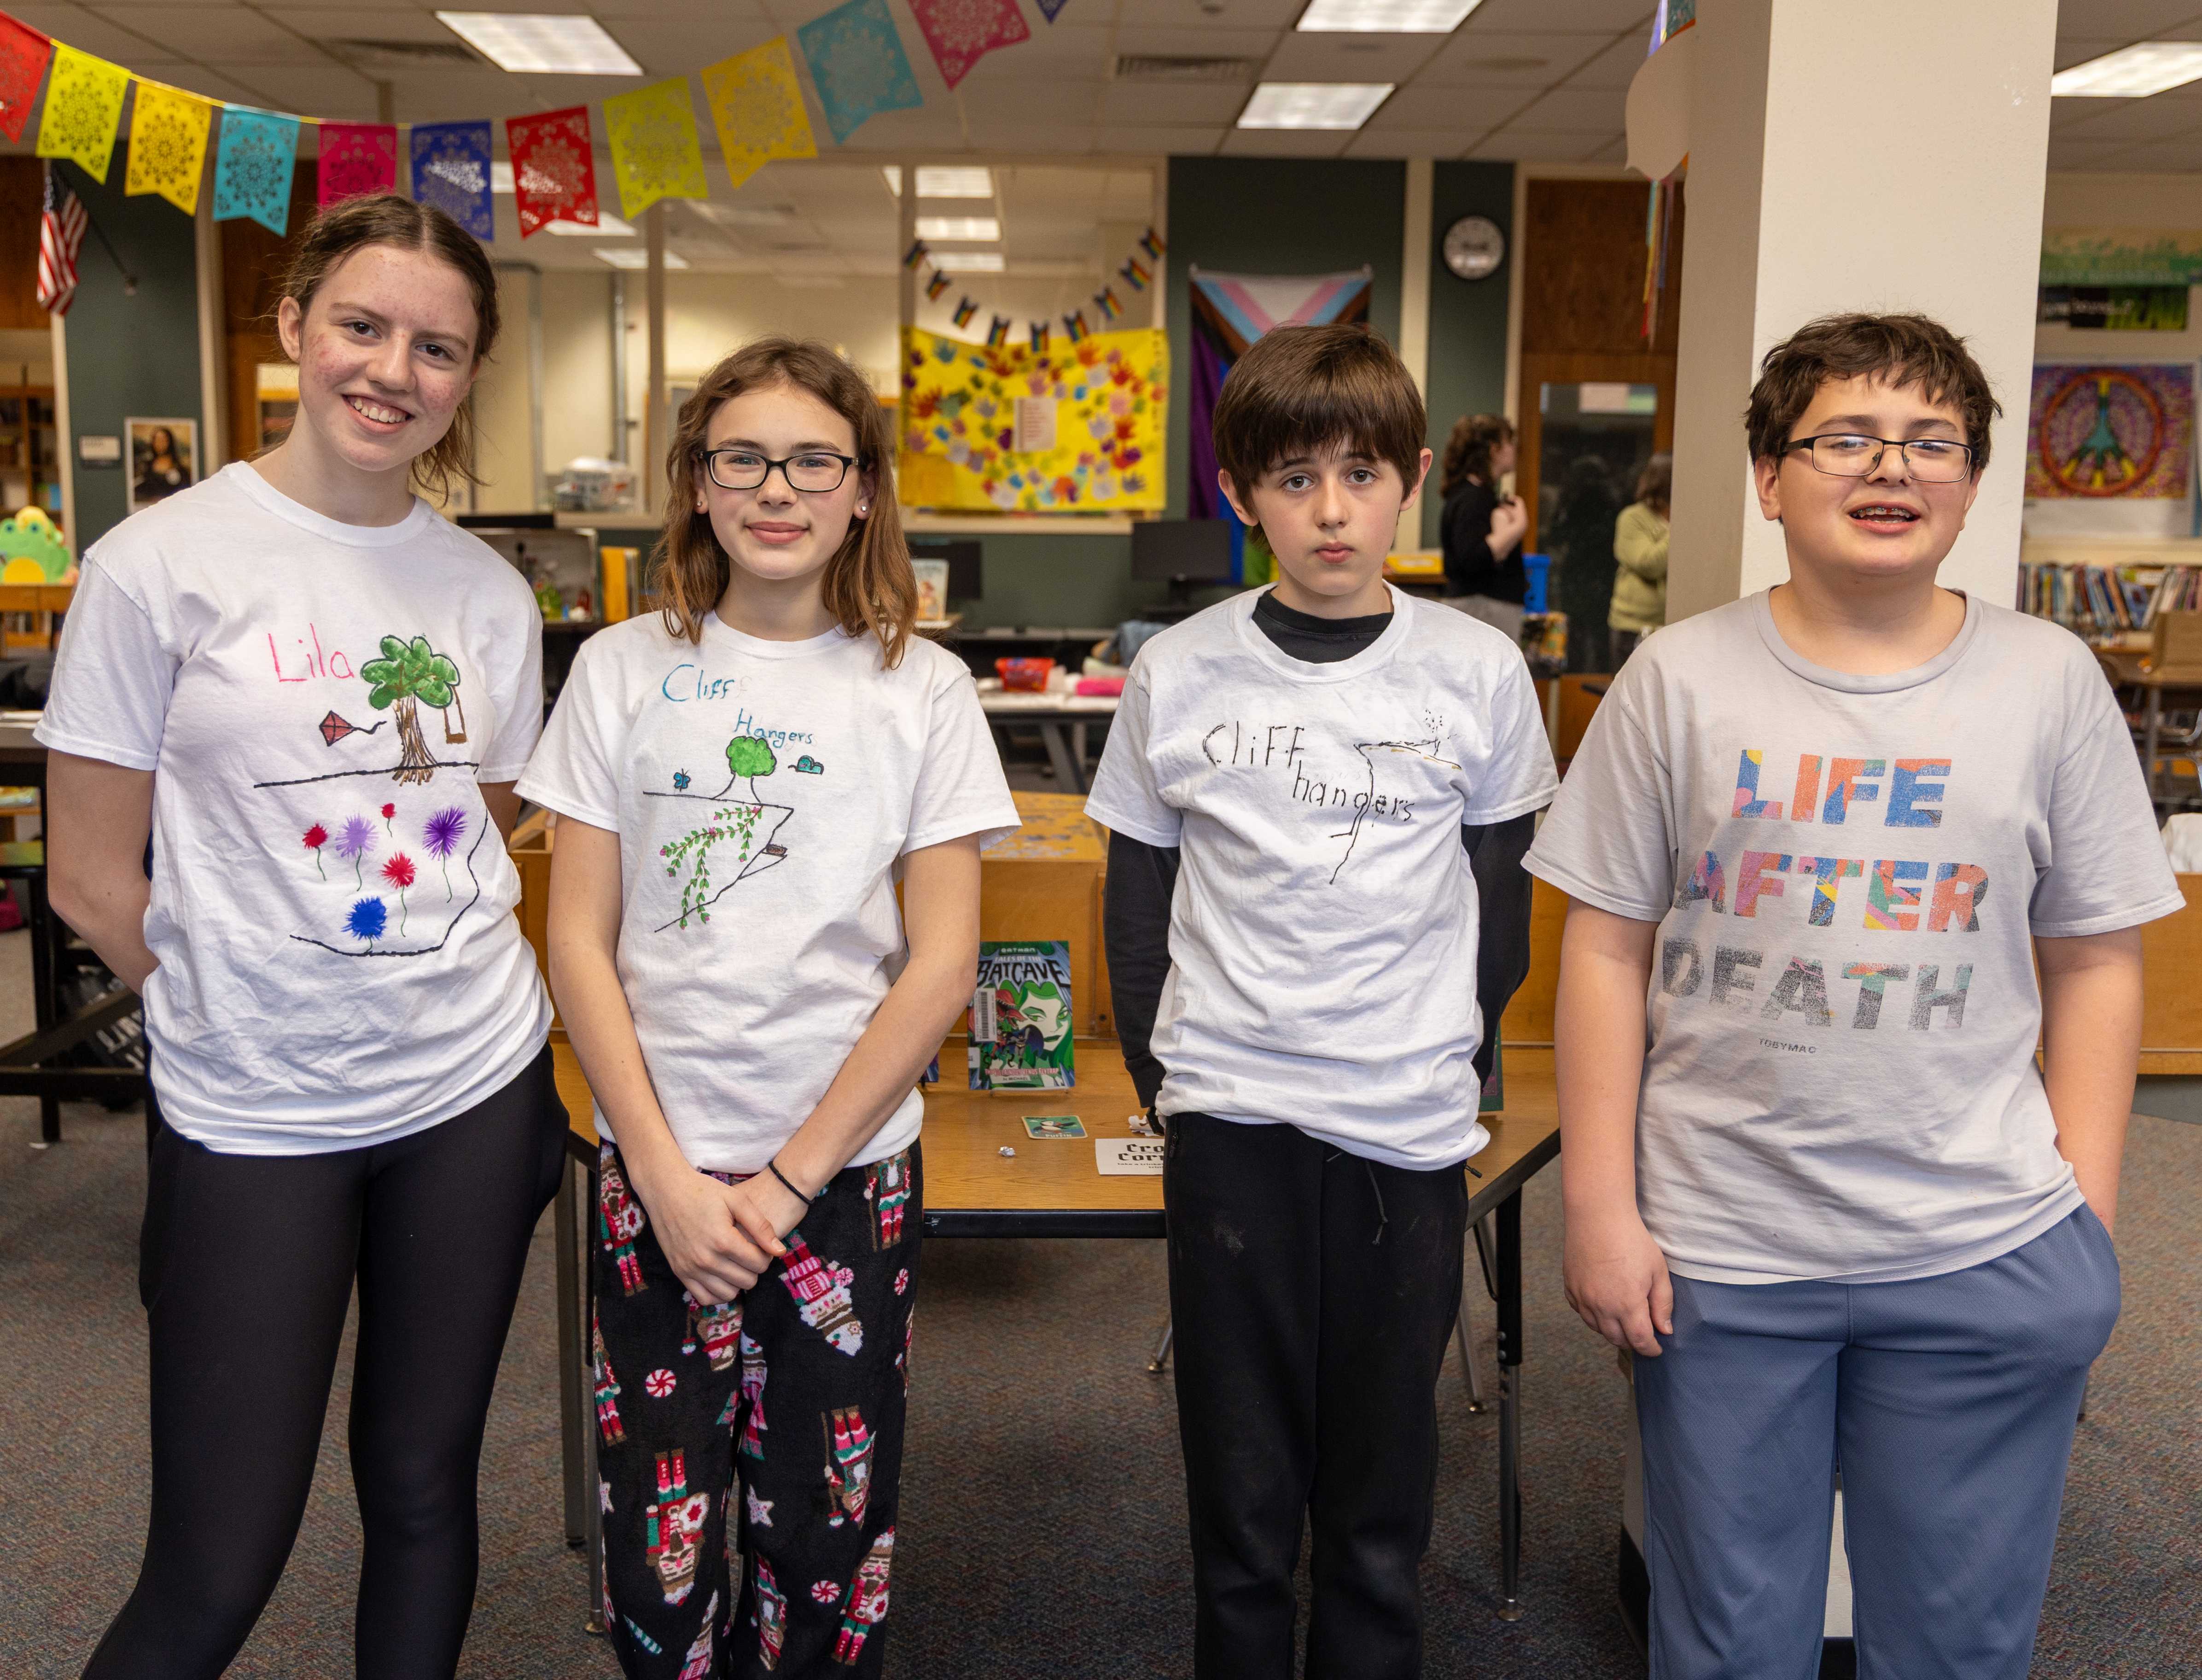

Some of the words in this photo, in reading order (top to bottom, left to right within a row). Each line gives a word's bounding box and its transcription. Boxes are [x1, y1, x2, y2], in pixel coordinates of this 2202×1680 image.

[268, 623, 355, 682] Lila
[662, 664, 735, 701] Cliff
[733, 708, 813, 749] Hangers
[1293, 759, 1415, 838] hangers
[1731, 749, 1952, 828] LIFE
[1672, 850, 1989, 933] AFTER
[977, 958, 1071, 988] BATCAVE
[1662, 937, 1974, 1031] DEATH
[1758, 1038, 1817, 1054] TOBYMAC
